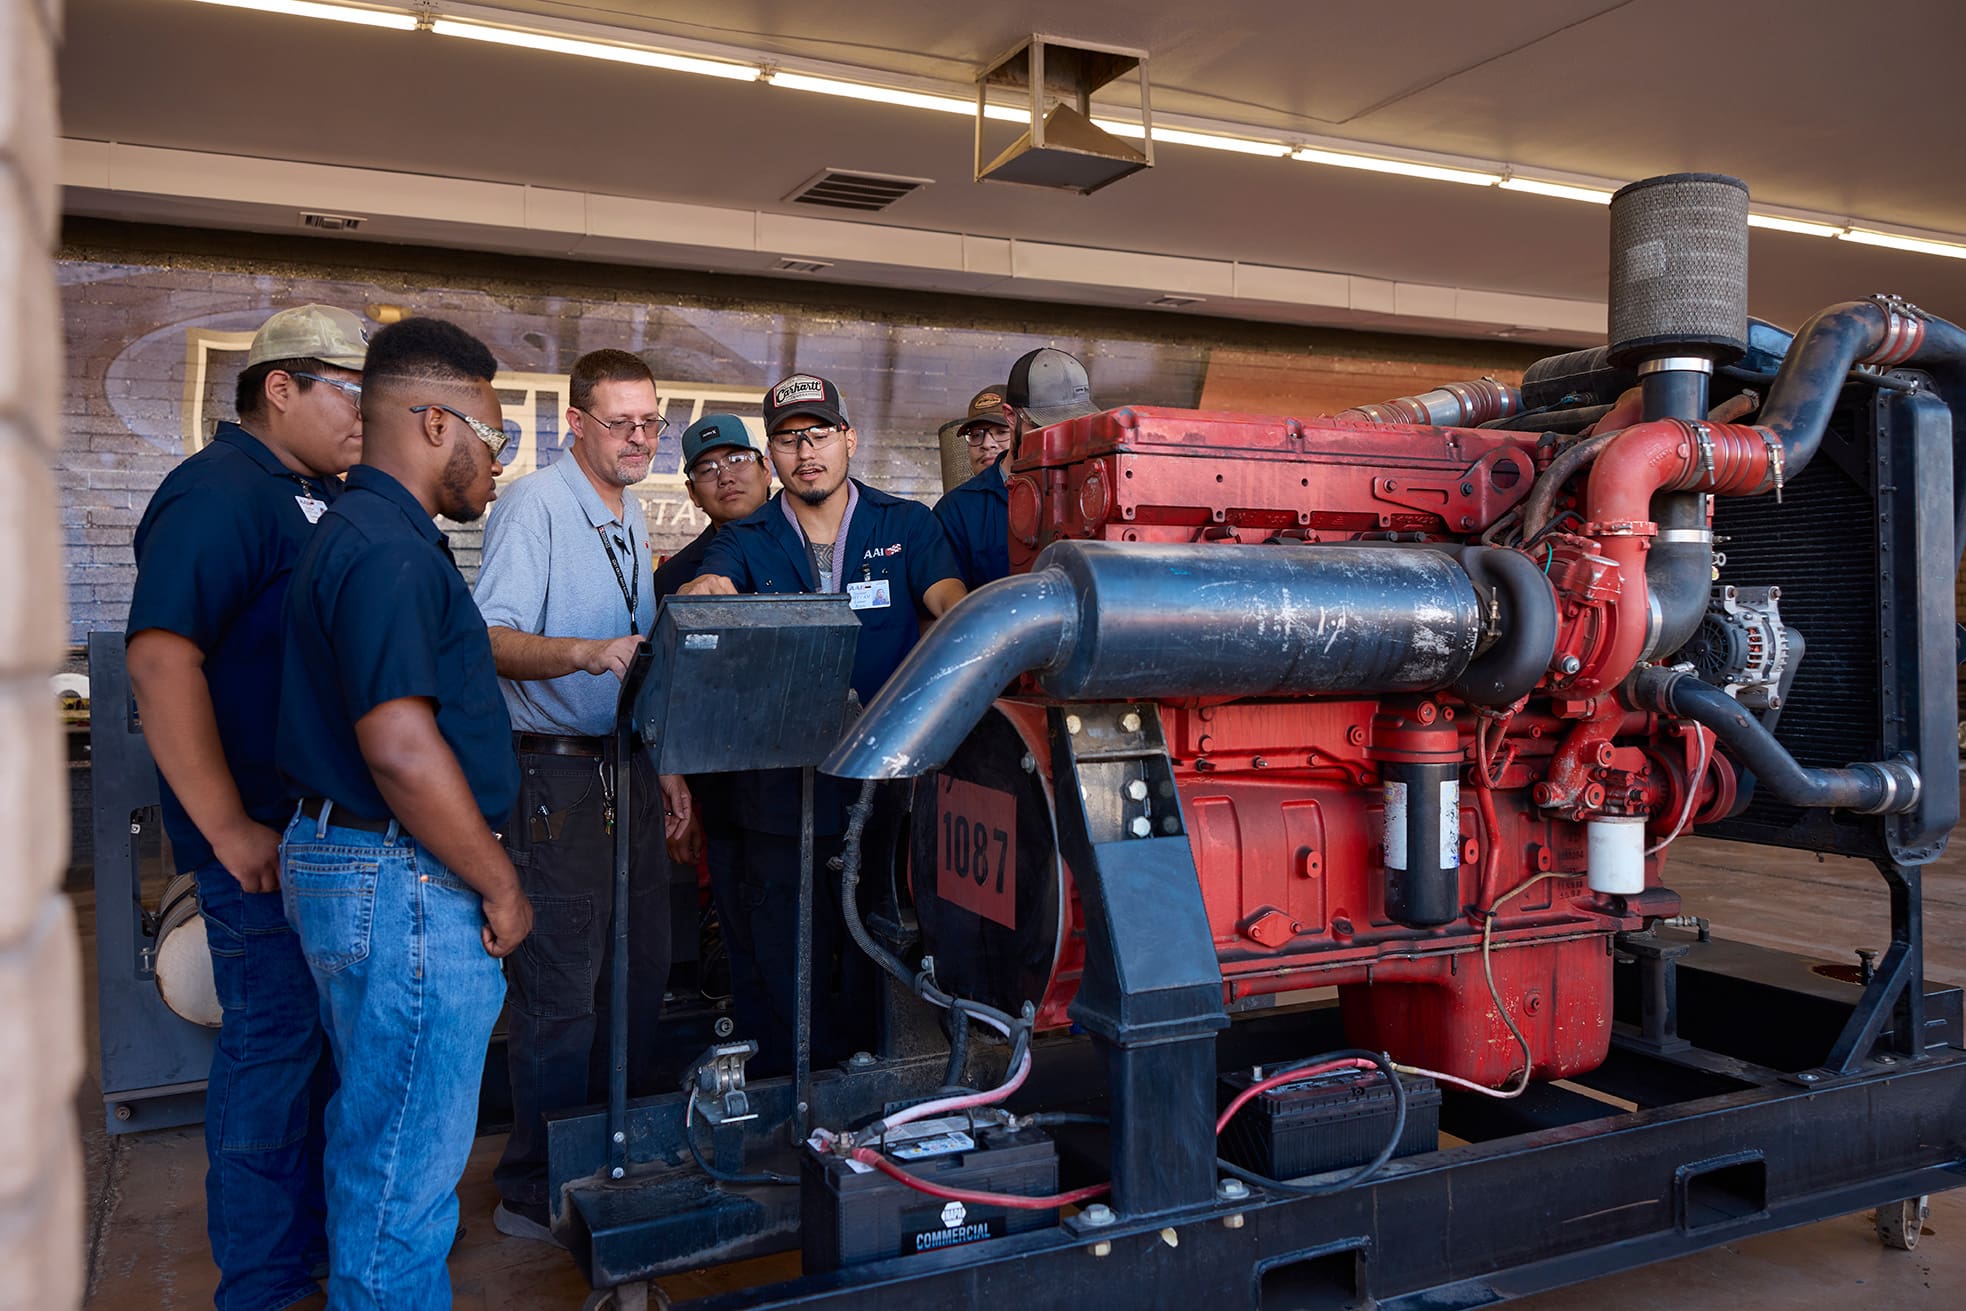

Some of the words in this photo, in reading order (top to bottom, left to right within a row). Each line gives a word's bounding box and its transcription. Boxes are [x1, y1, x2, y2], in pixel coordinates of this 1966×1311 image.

[776, 381, 822, 403] Carhartt
[863, 547, 884, 559] AAI
[944, 812, 1008, 893] 1087
[916, 1222, 991, 1250] COMMERCIAL
